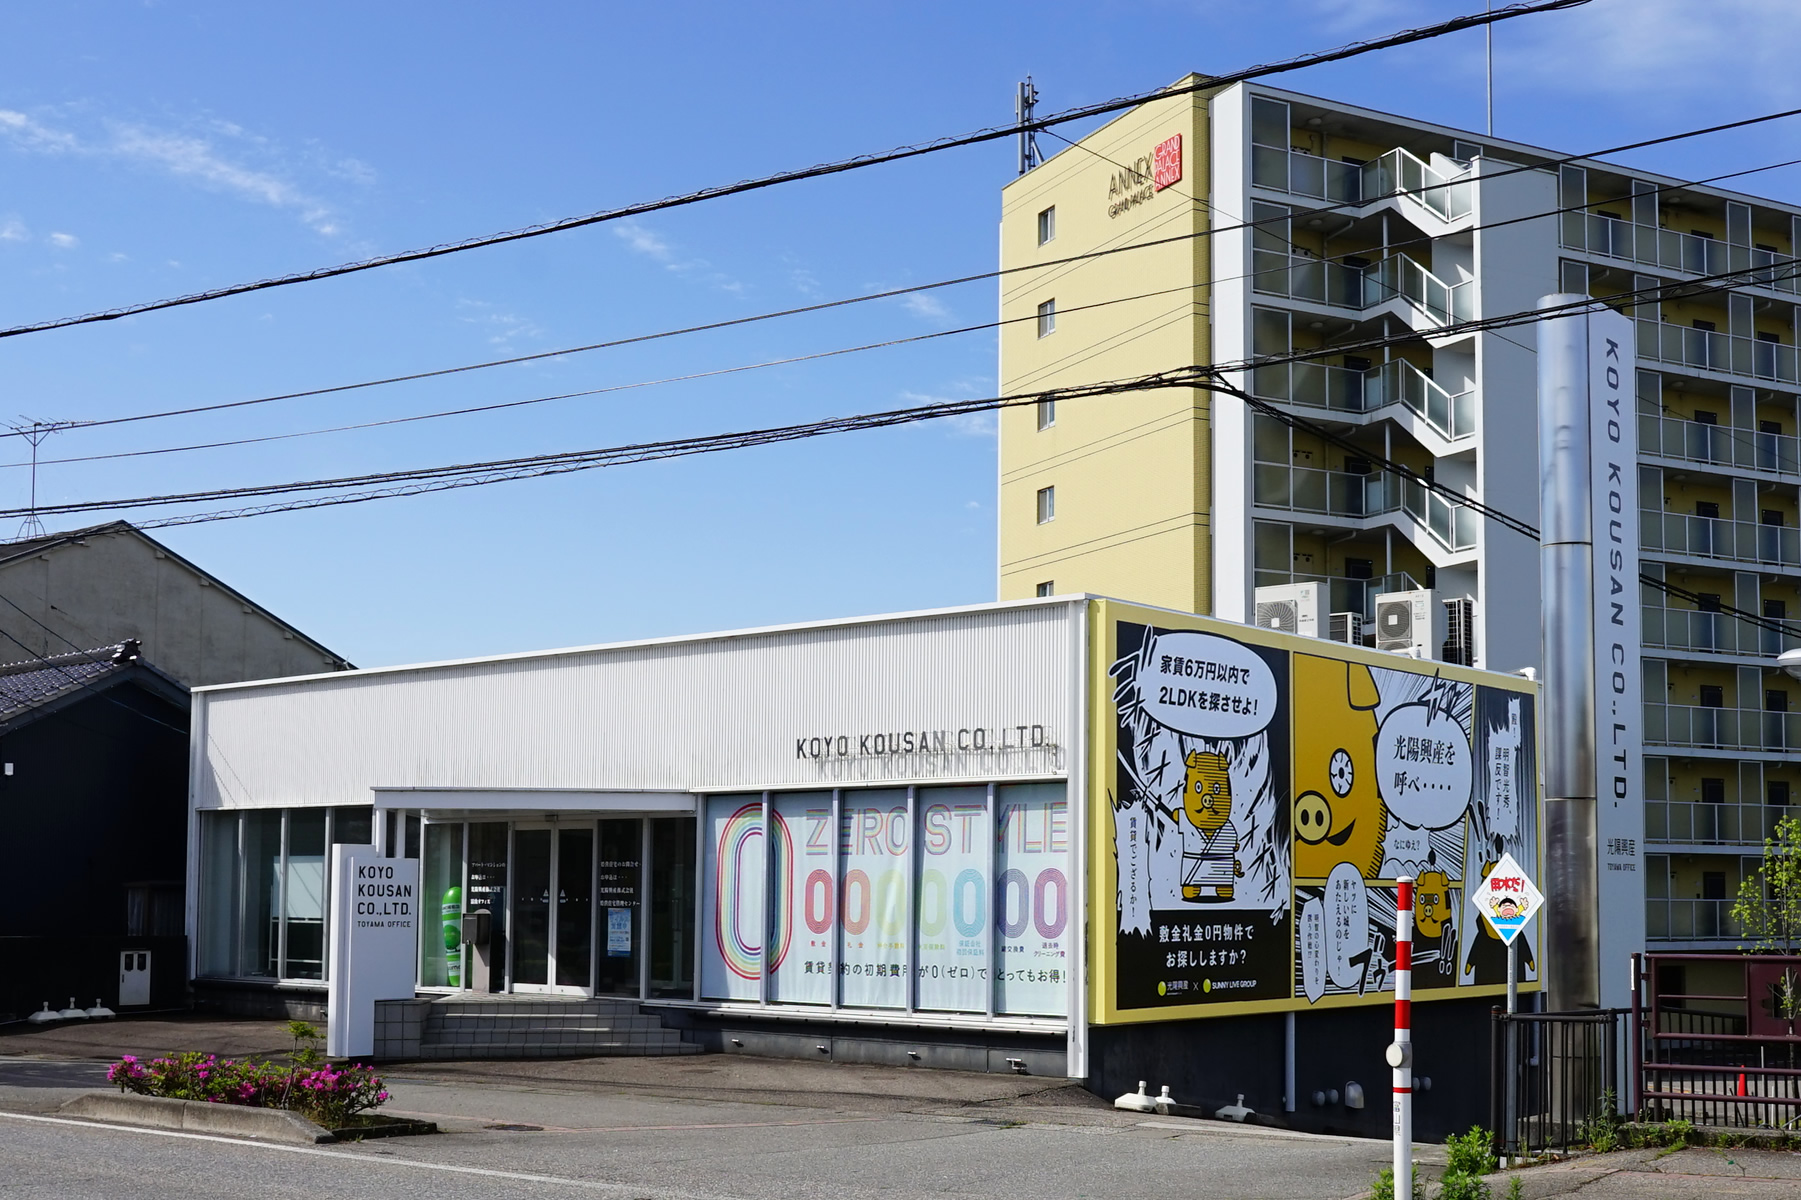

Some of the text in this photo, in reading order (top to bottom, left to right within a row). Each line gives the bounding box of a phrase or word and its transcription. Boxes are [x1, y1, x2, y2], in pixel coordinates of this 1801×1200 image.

[1108, 152, 1154, 201] ANNEX
[1606, 337, 1621, 443] KOYO
[1608, 462, 1623, 626] KOUSAN
[1160, 654, 1250, 685] 家賃6万円以内で
[1158, 686, 1258, 715] 2LDKを探させよ!
[797, 736, 848, 760] KOYO
[860, 731, 946, 757] KOUSAN
[1393, 734, 1455, 766] 光陽興産を
[1394, 839, 1420, 851] なにゆえ?
[1607, 838, 1635, 856] 光陽興産
[358, 866, 393, 879] KOYO
[358, 884, 412, 897] KOUSAN
[357, 902, 412, 916] CO.,LTD.
[1159, 924, 1254, 943] 敷金礼金0円物件で
[1166, 950, 1247, 968] お探ししますか?
[1212, 981, 1229, 990] SUNNY
[1229, 980, 1239, 989] LIVE
[1240, 979, 1257, 988] GROUP
